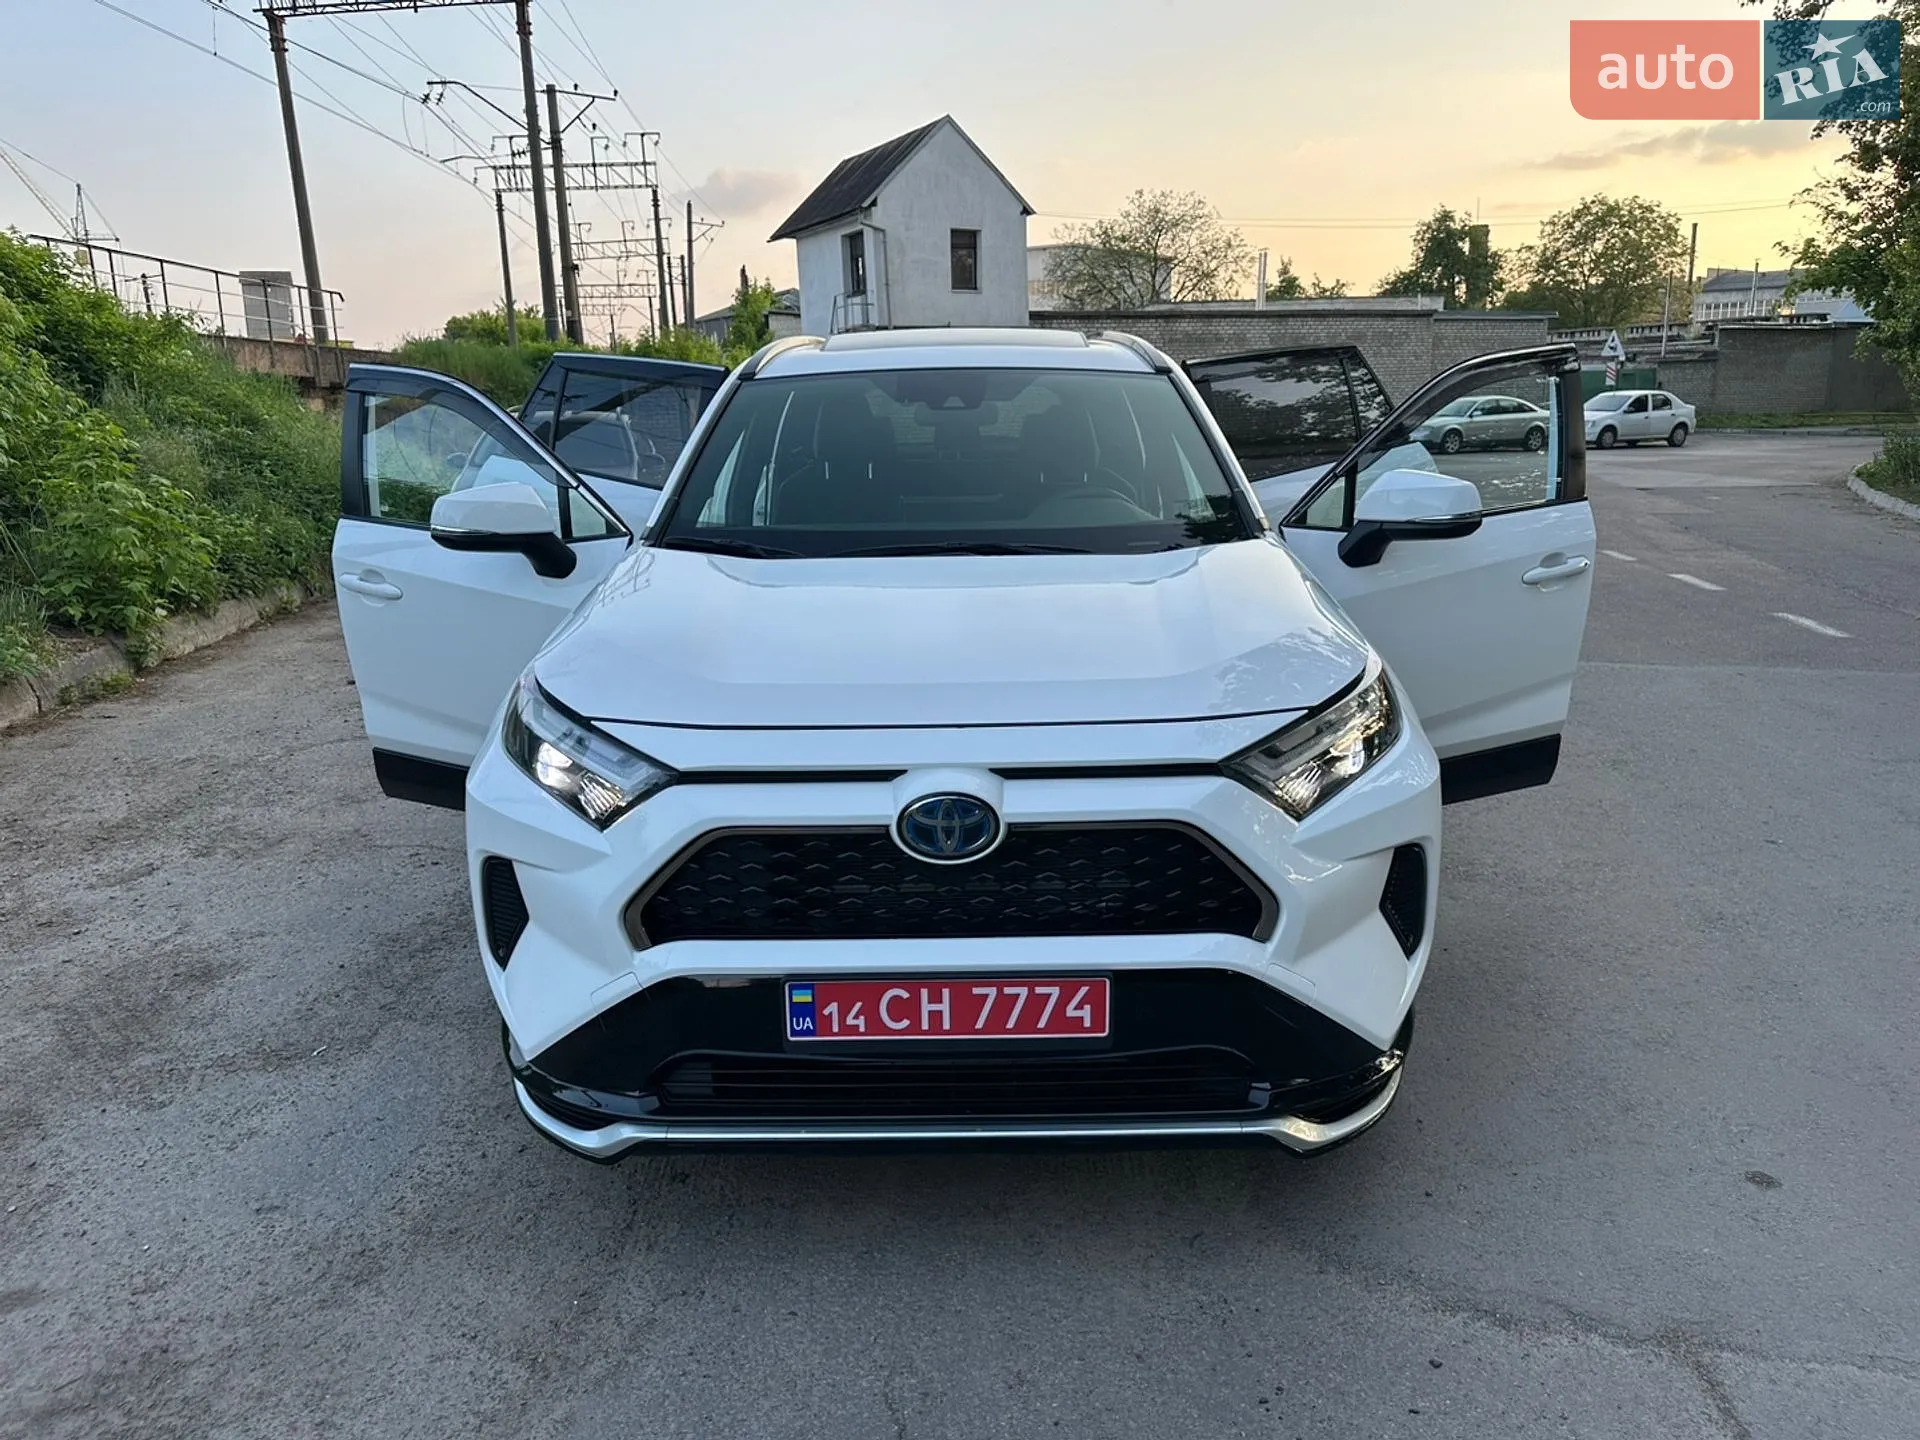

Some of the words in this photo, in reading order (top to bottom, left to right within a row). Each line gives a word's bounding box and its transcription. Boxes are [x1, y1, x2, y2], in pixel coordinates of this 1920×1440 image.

[793, 1017, 814, 1031] UA
[822, 1002, 866, 1033] 14
[879, 988, 950, 1031] CH
[972, 986, 1091, 1030] 7774
